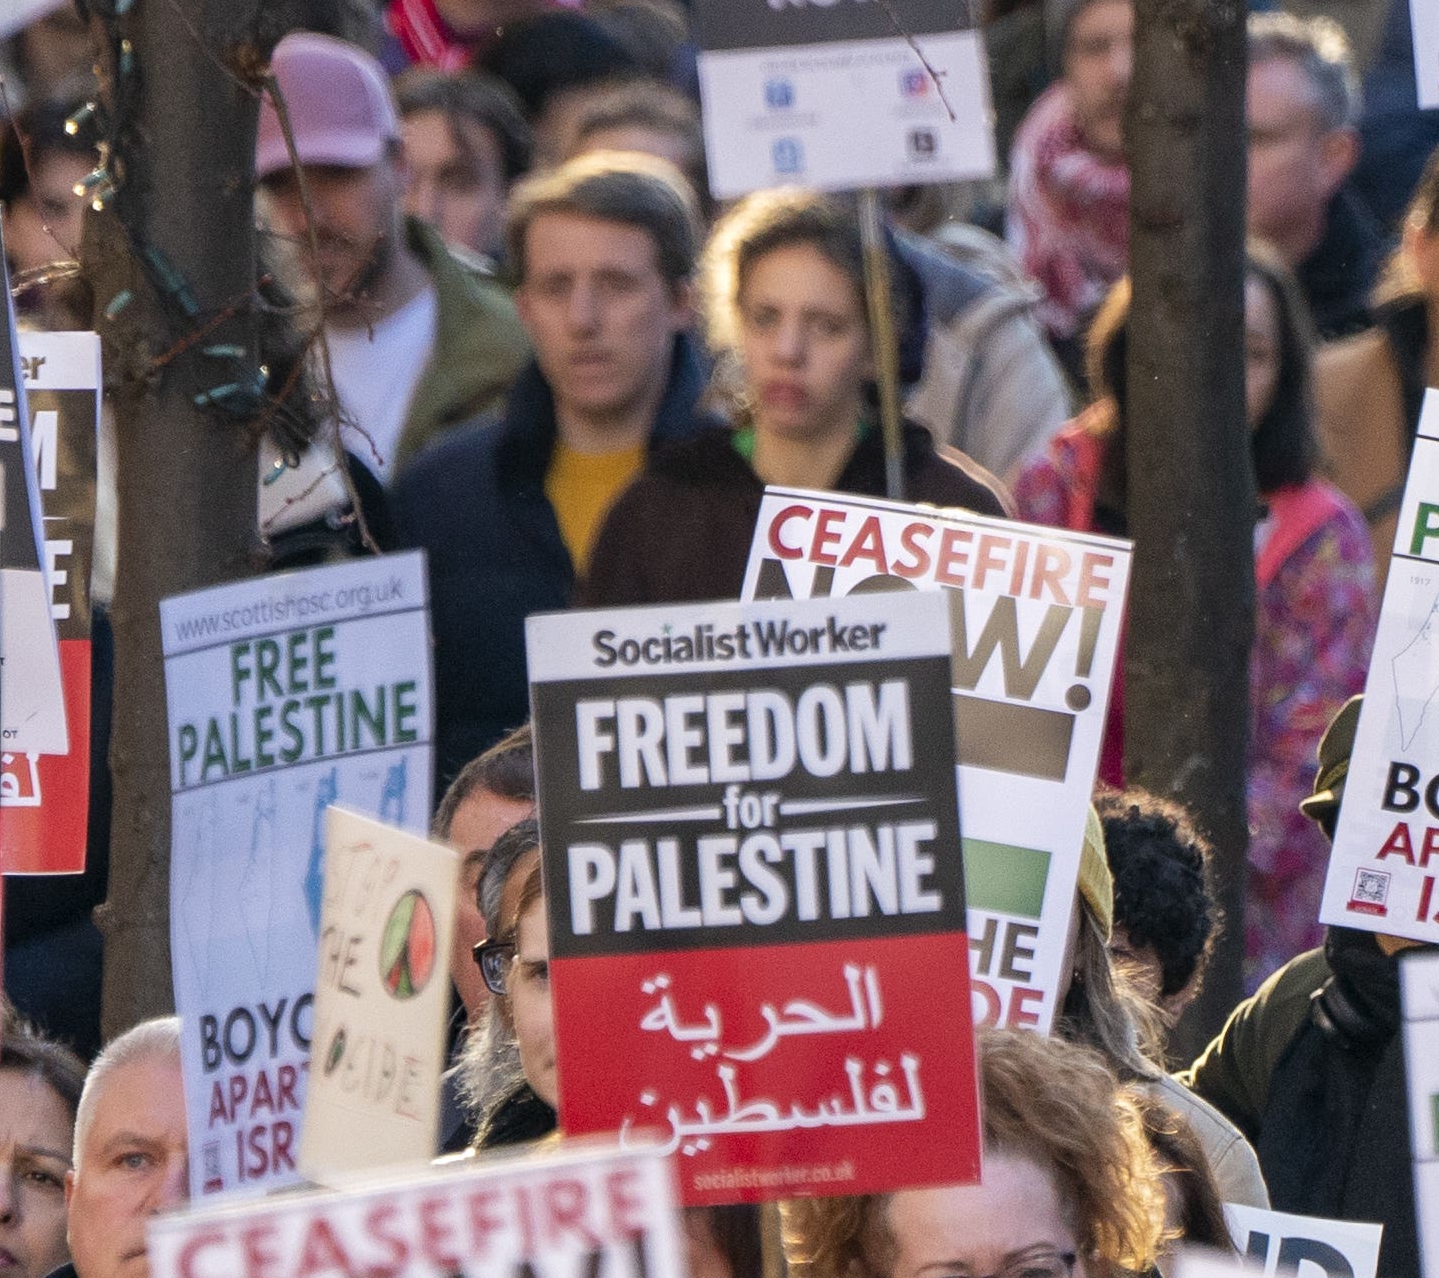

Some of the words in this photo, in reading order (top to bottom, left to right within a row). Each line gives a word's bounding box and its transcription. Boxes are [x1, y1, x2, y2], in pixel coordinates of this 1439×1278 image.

[174, 575, 405, 643] www.scottishpsc.org.uk
[767, 504, 1113, 612] CEASEFIRE
[230, 627, 337, 707] FREE
[177, 680, 418, 785] PALESTINE
[576, 679, 913, 791] FREEDOM
[723, 782, 780, 831] for
[566, 822, 943, 935] PALESTINE
